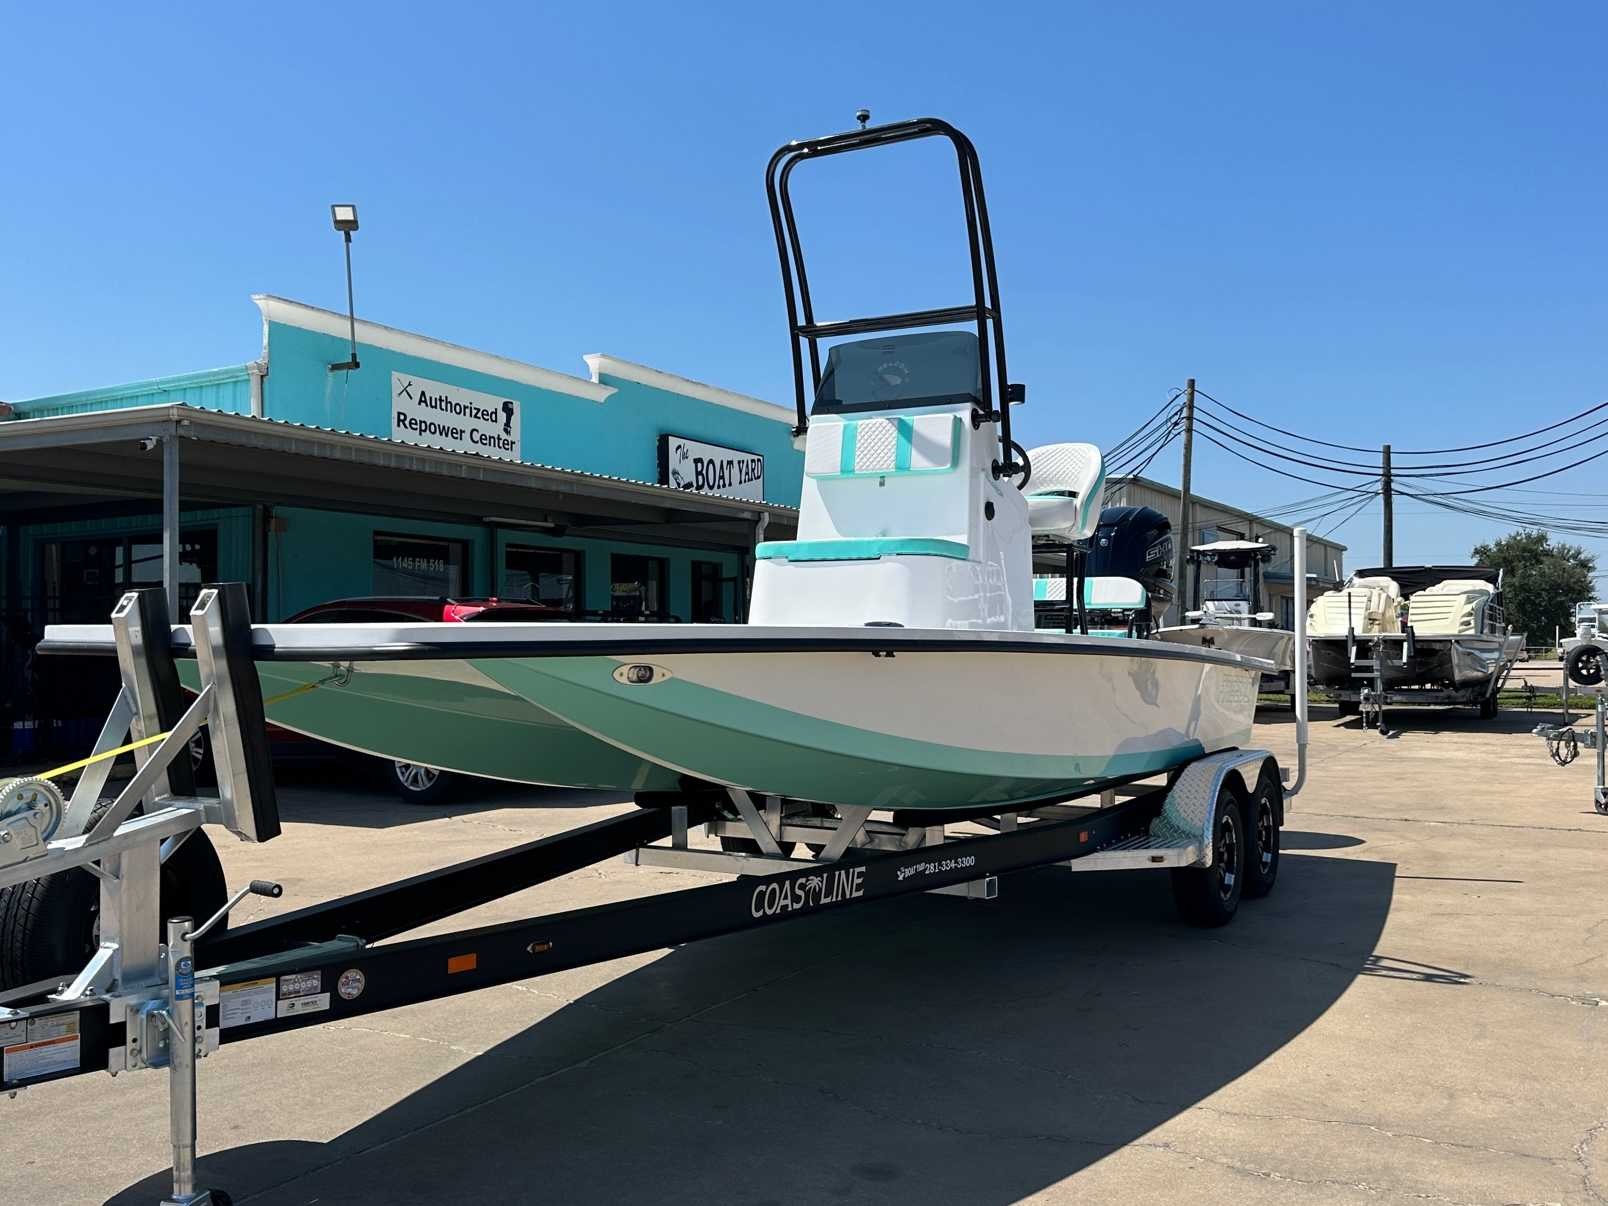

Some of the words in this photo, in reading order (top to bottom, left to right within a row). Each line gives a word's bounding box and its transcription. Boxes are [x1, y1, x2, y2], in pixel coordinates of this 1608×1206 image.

[418, 390, 498, 424] Authorized
[396, 411, 466, 441] Repower
[469, 428, 516, 452] Center
[675, 443, 690, 464] The
[693, 457, 735, 491] BOAT
[737, 458, 762, 485] YARD
[415, 557, 427, 571] FM
[925, 856, 975, 874] 281-334-3300
